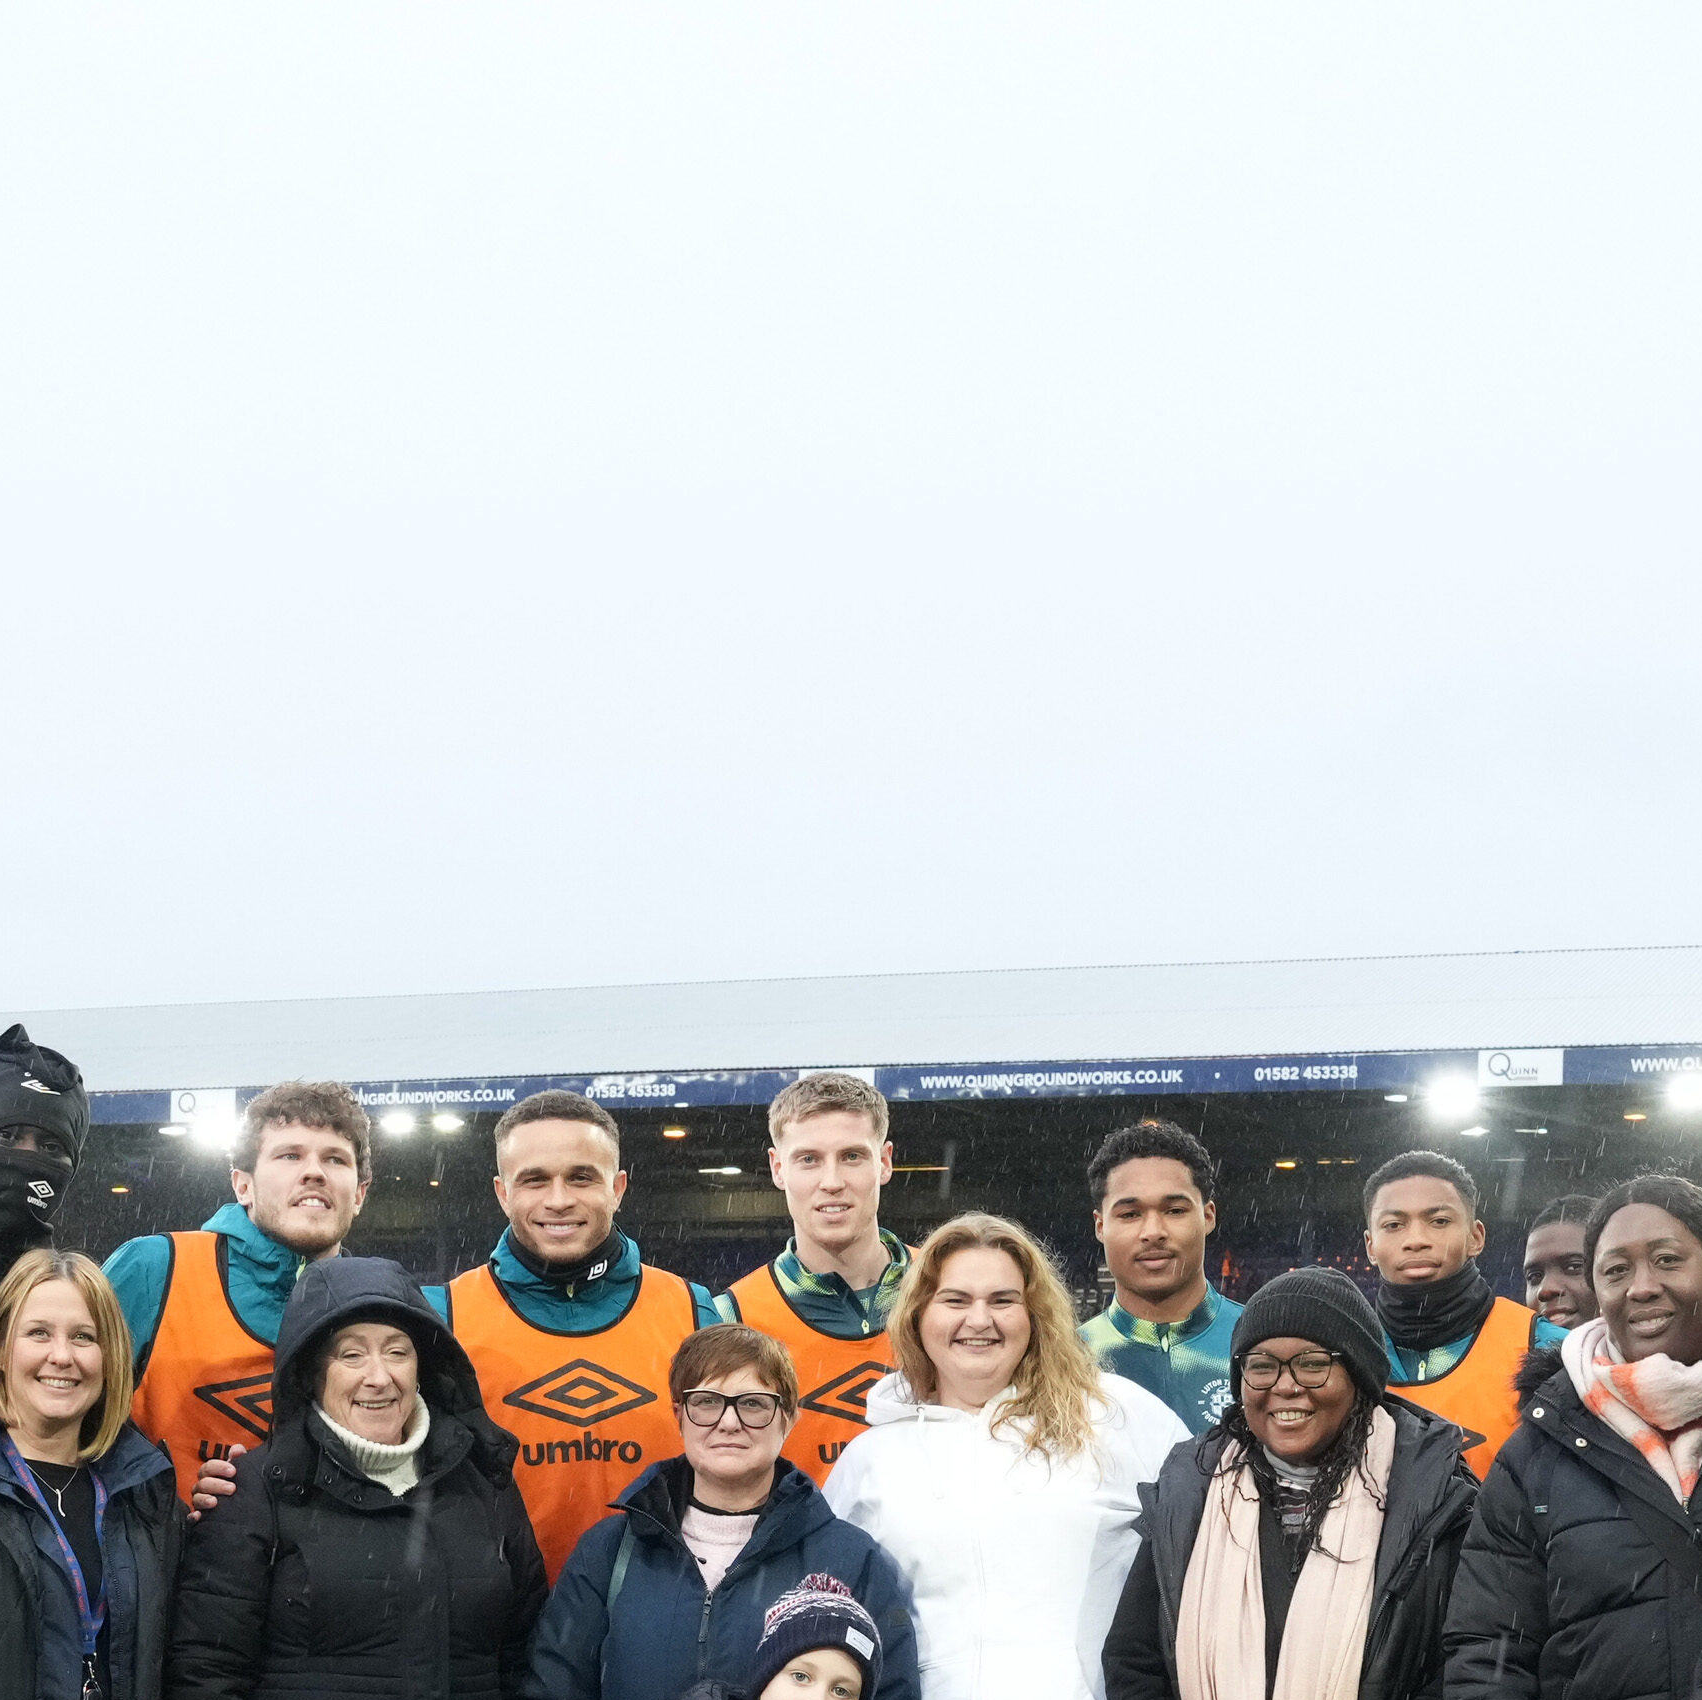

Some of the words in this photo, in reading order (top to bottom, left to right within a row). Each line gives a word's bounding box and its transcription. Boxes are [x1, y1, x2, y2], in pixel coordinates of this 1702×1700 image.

[920, 1068, 1183, 1090] WWW.QUINNGROUNDWORKS.CO.UK
[1254, 1066, 1298, 1082] 01582
[1303, 1064, 1358, 1081] 453338
[1488, 1052, 1538, 1080] QUINN
[585, 1084, 625, 1099] 01582
[627, 1082, 676, 1098] 453338
[1201, 1379, 1222, 1394] LUTON
[522, 1431, 642, 1466] umbro
